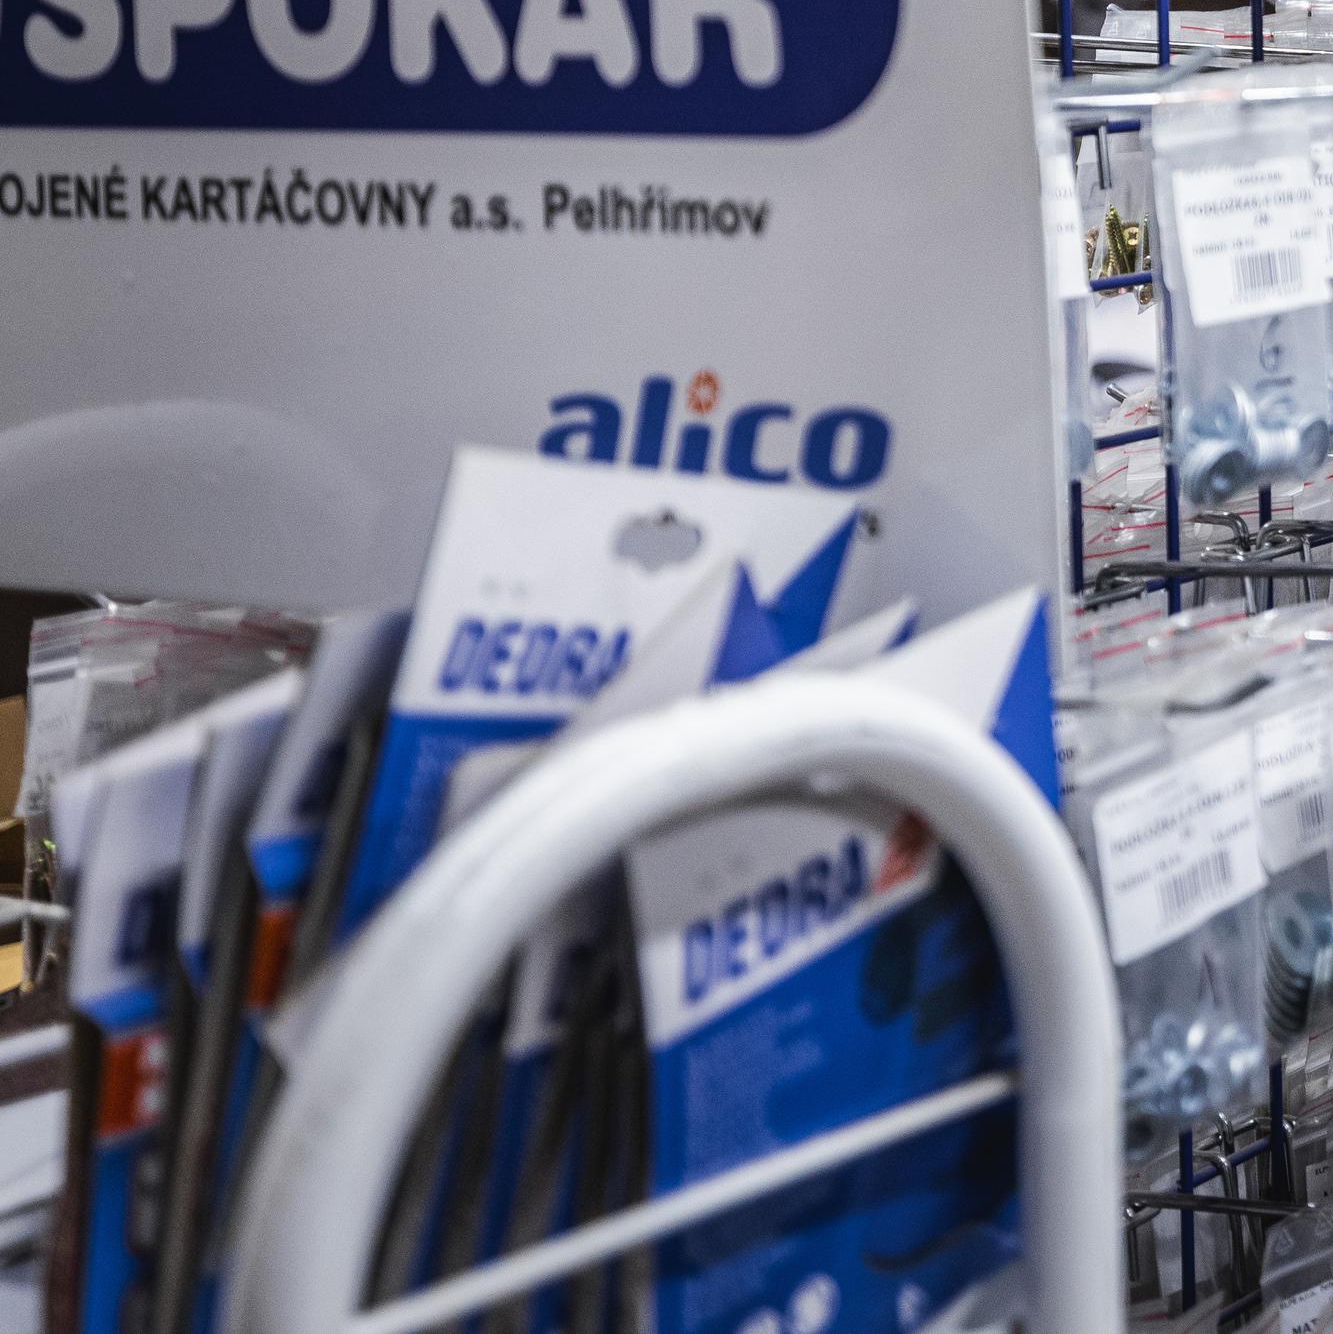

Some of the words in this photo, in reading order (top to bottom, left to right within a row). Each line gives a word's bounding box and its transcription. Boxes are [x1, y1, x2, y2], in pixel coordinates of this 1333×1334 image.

[141, 165, 437, 229] KARTÁČOVNY
[450, 191, 523, 233] a.s.
[542, 182, 770, 238] Pelhřimov
[538, 369, 893, 493] alico
